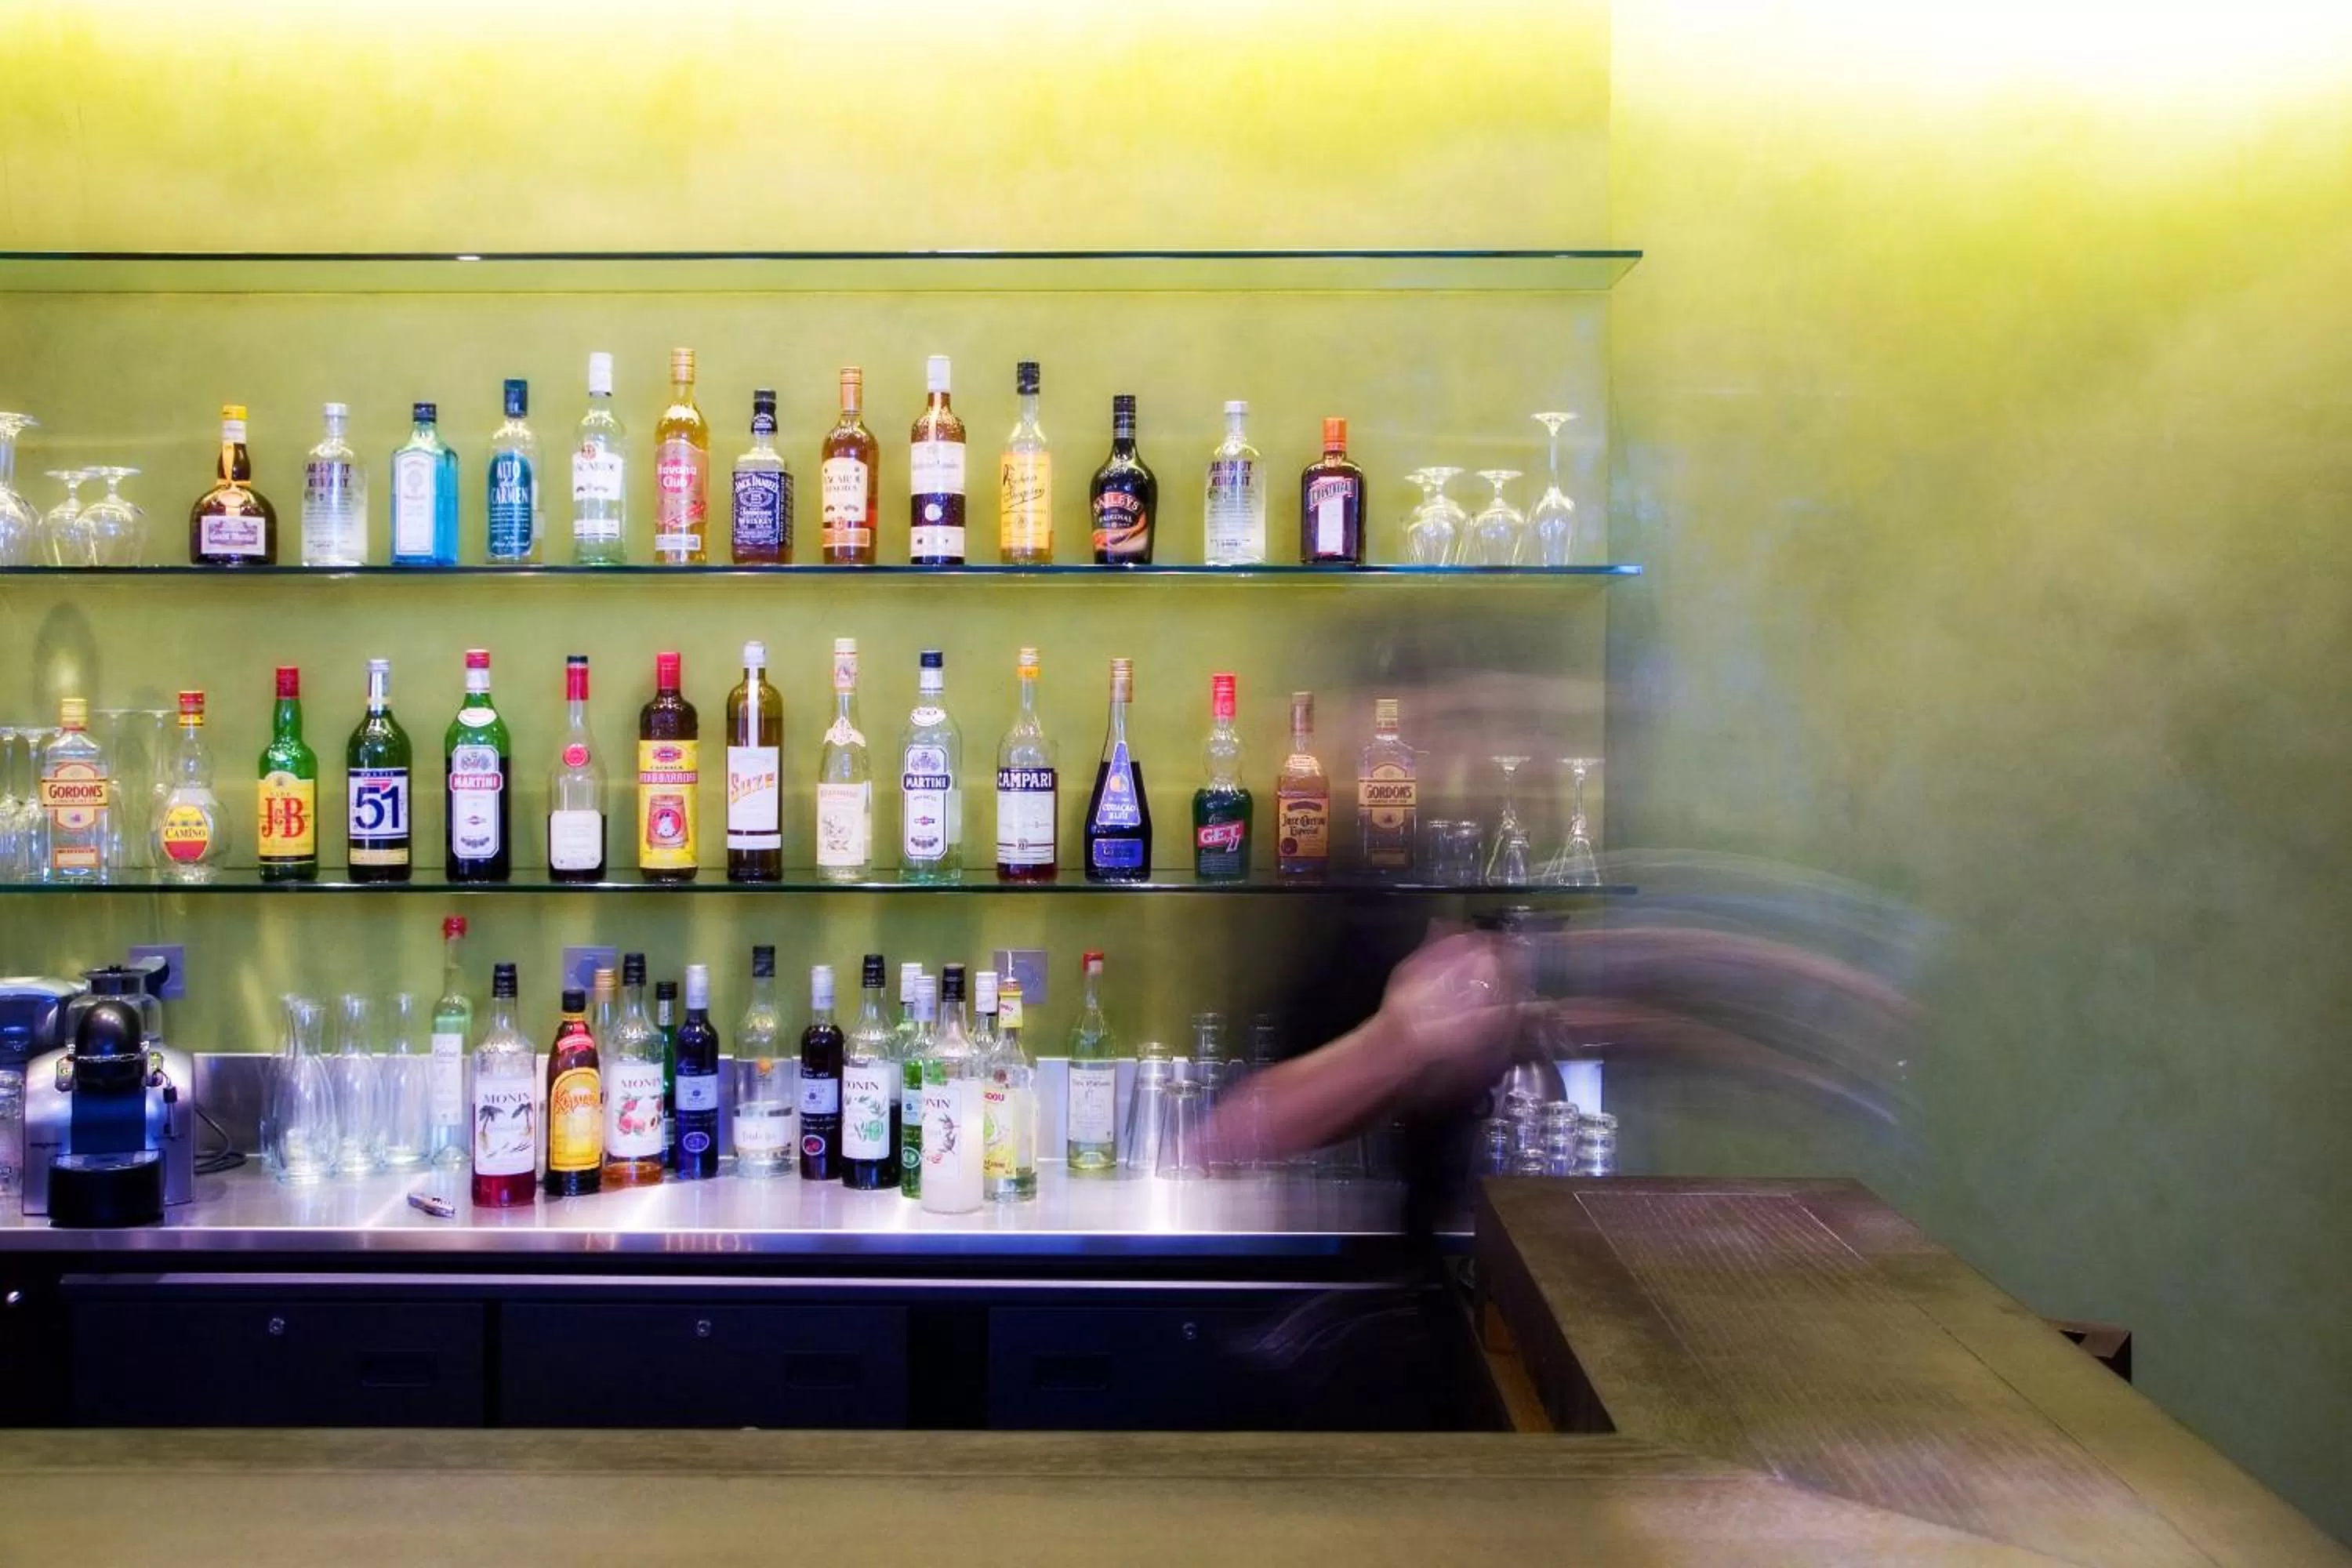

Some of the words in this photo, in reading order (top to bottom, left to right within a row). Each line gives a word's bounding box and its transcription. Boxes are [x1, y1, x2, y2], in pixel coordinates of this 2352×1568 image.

[662, 475, 688, 488] Club
[906, 776, 946, 788] MARTINI
[355, 785, 399, 829] 51
[261, 797, 305, 838] J&B
[847, 1081, 879, 1091] ONIN
